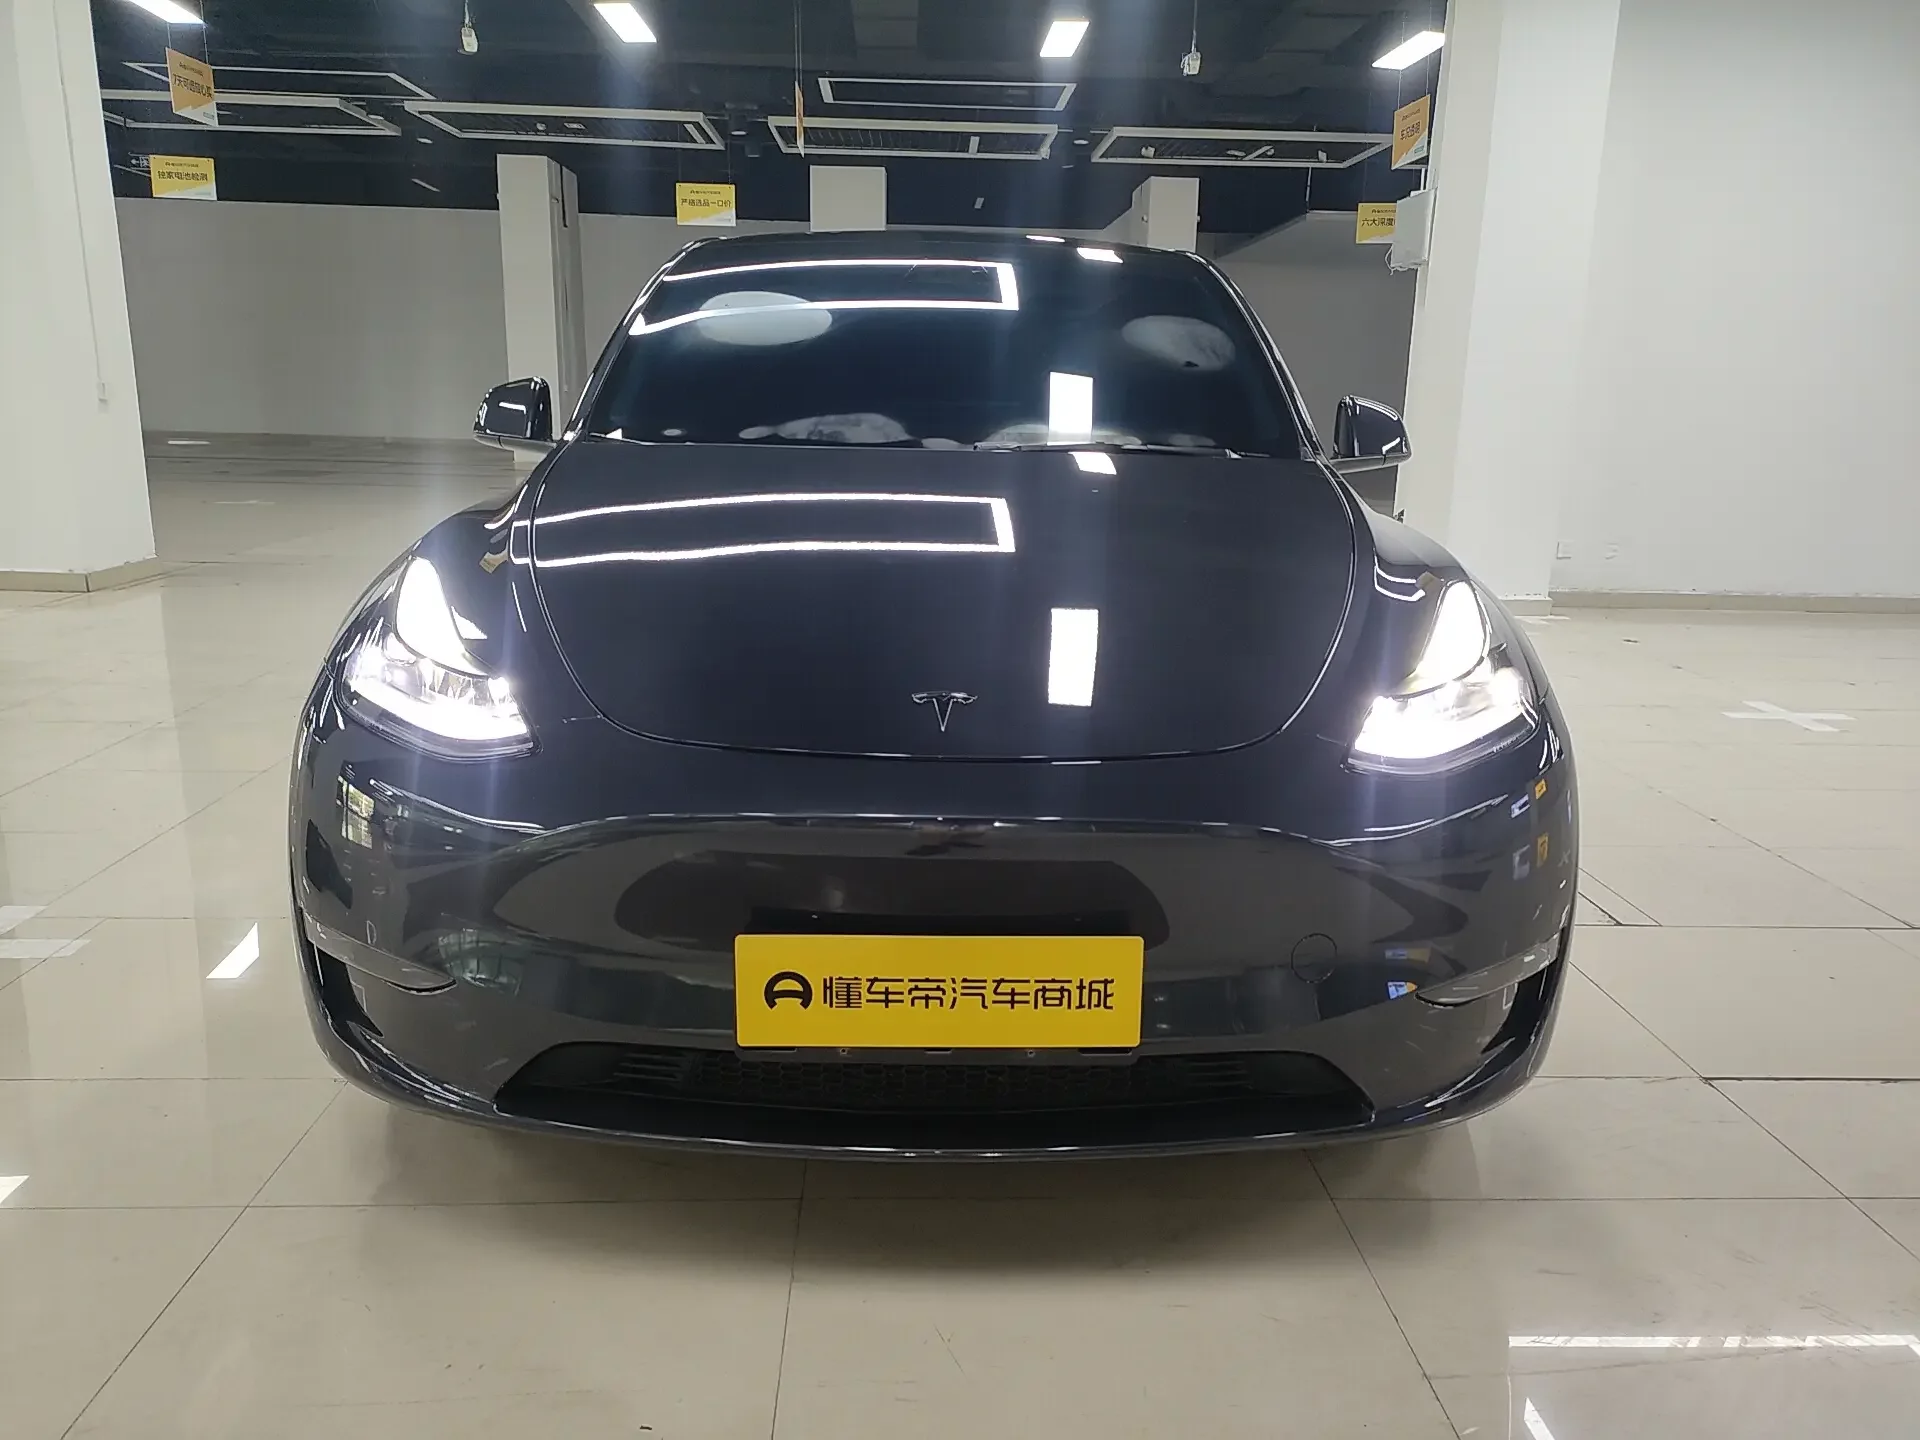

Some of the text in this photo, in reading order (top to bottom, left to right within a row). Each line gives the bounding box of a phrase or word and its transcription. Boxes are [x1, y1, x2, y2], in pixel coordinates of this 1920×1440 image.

[1361, 217, 1395, 226] 六大深度
[822, 976, 1115, 1010] 懂车帝汽车商城
